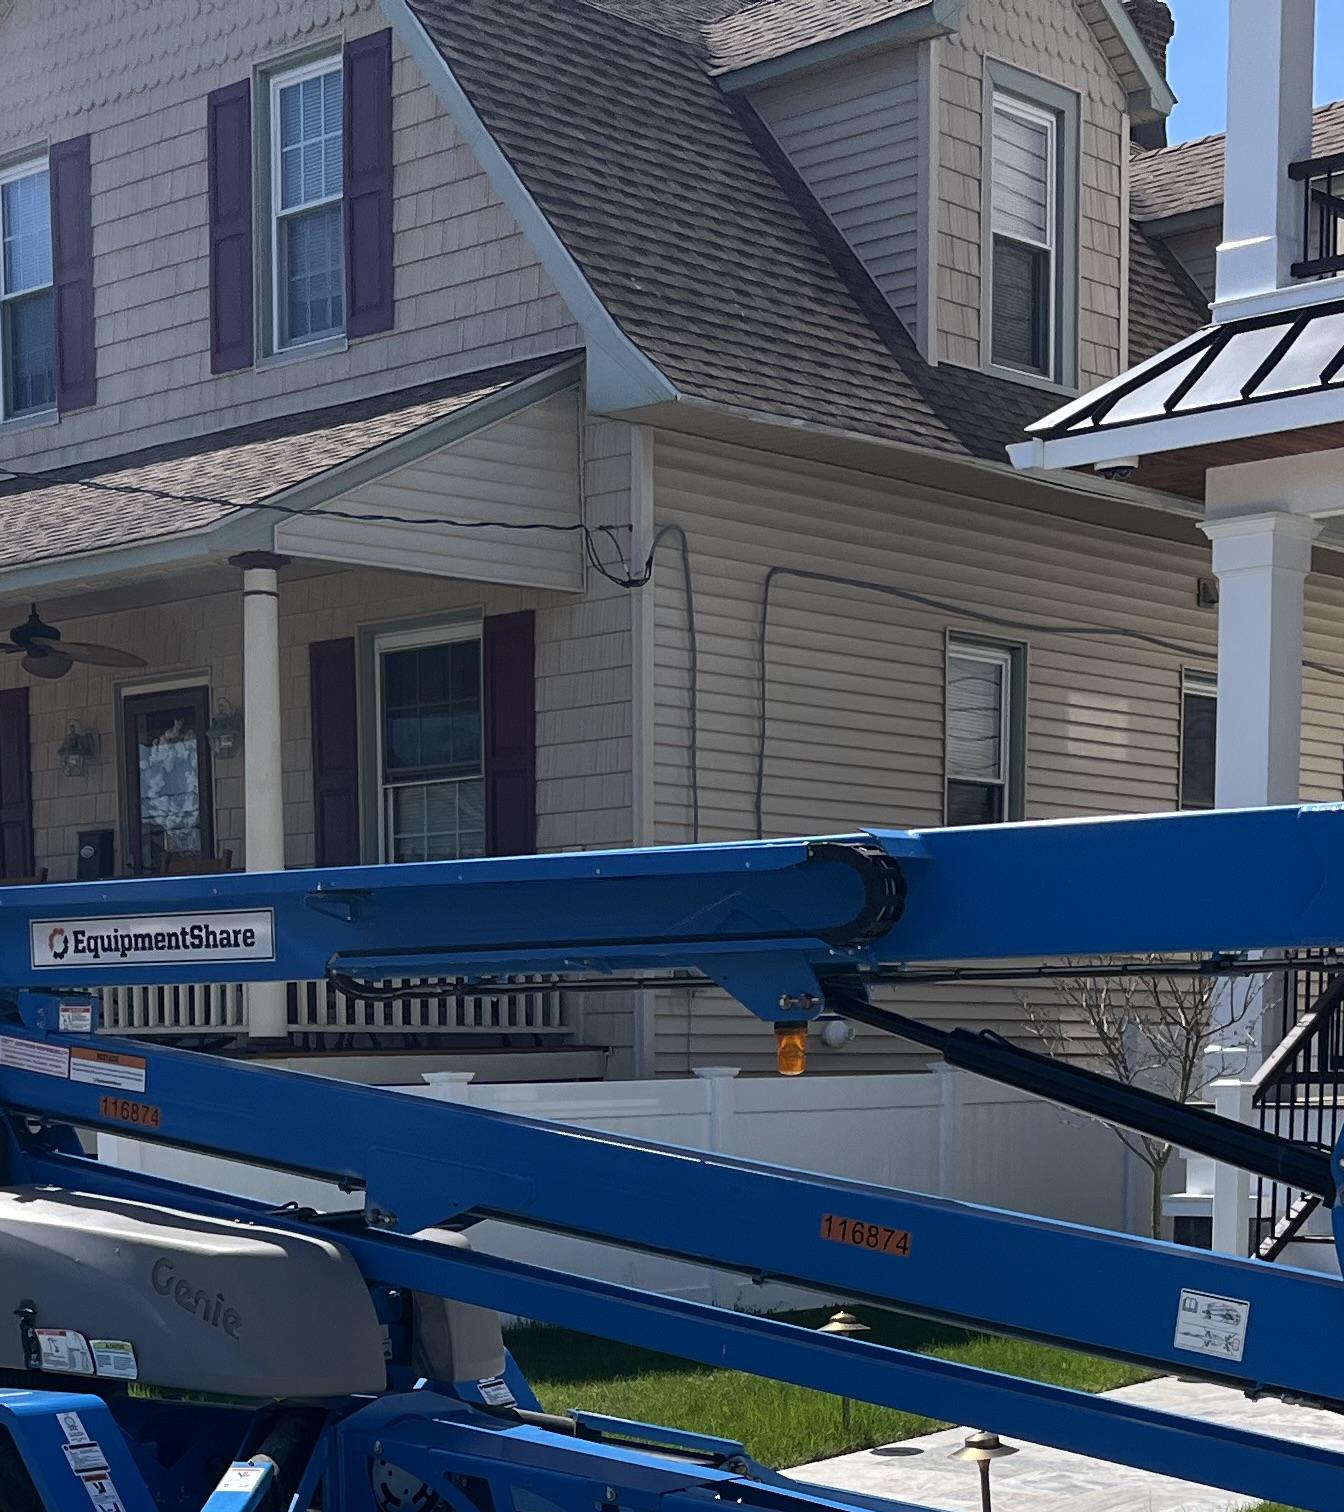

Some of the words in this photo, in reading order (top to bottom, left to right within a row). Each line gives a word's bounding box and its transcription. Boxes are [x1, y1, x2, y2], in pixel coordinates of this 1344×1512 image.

[73, 925, 255, 958] EquipmentShare
[102, 1097, 159, 1125] 116874
[825, 1215, 909, 1255] 116874
[152, 1257, 242, 1340] Genie
